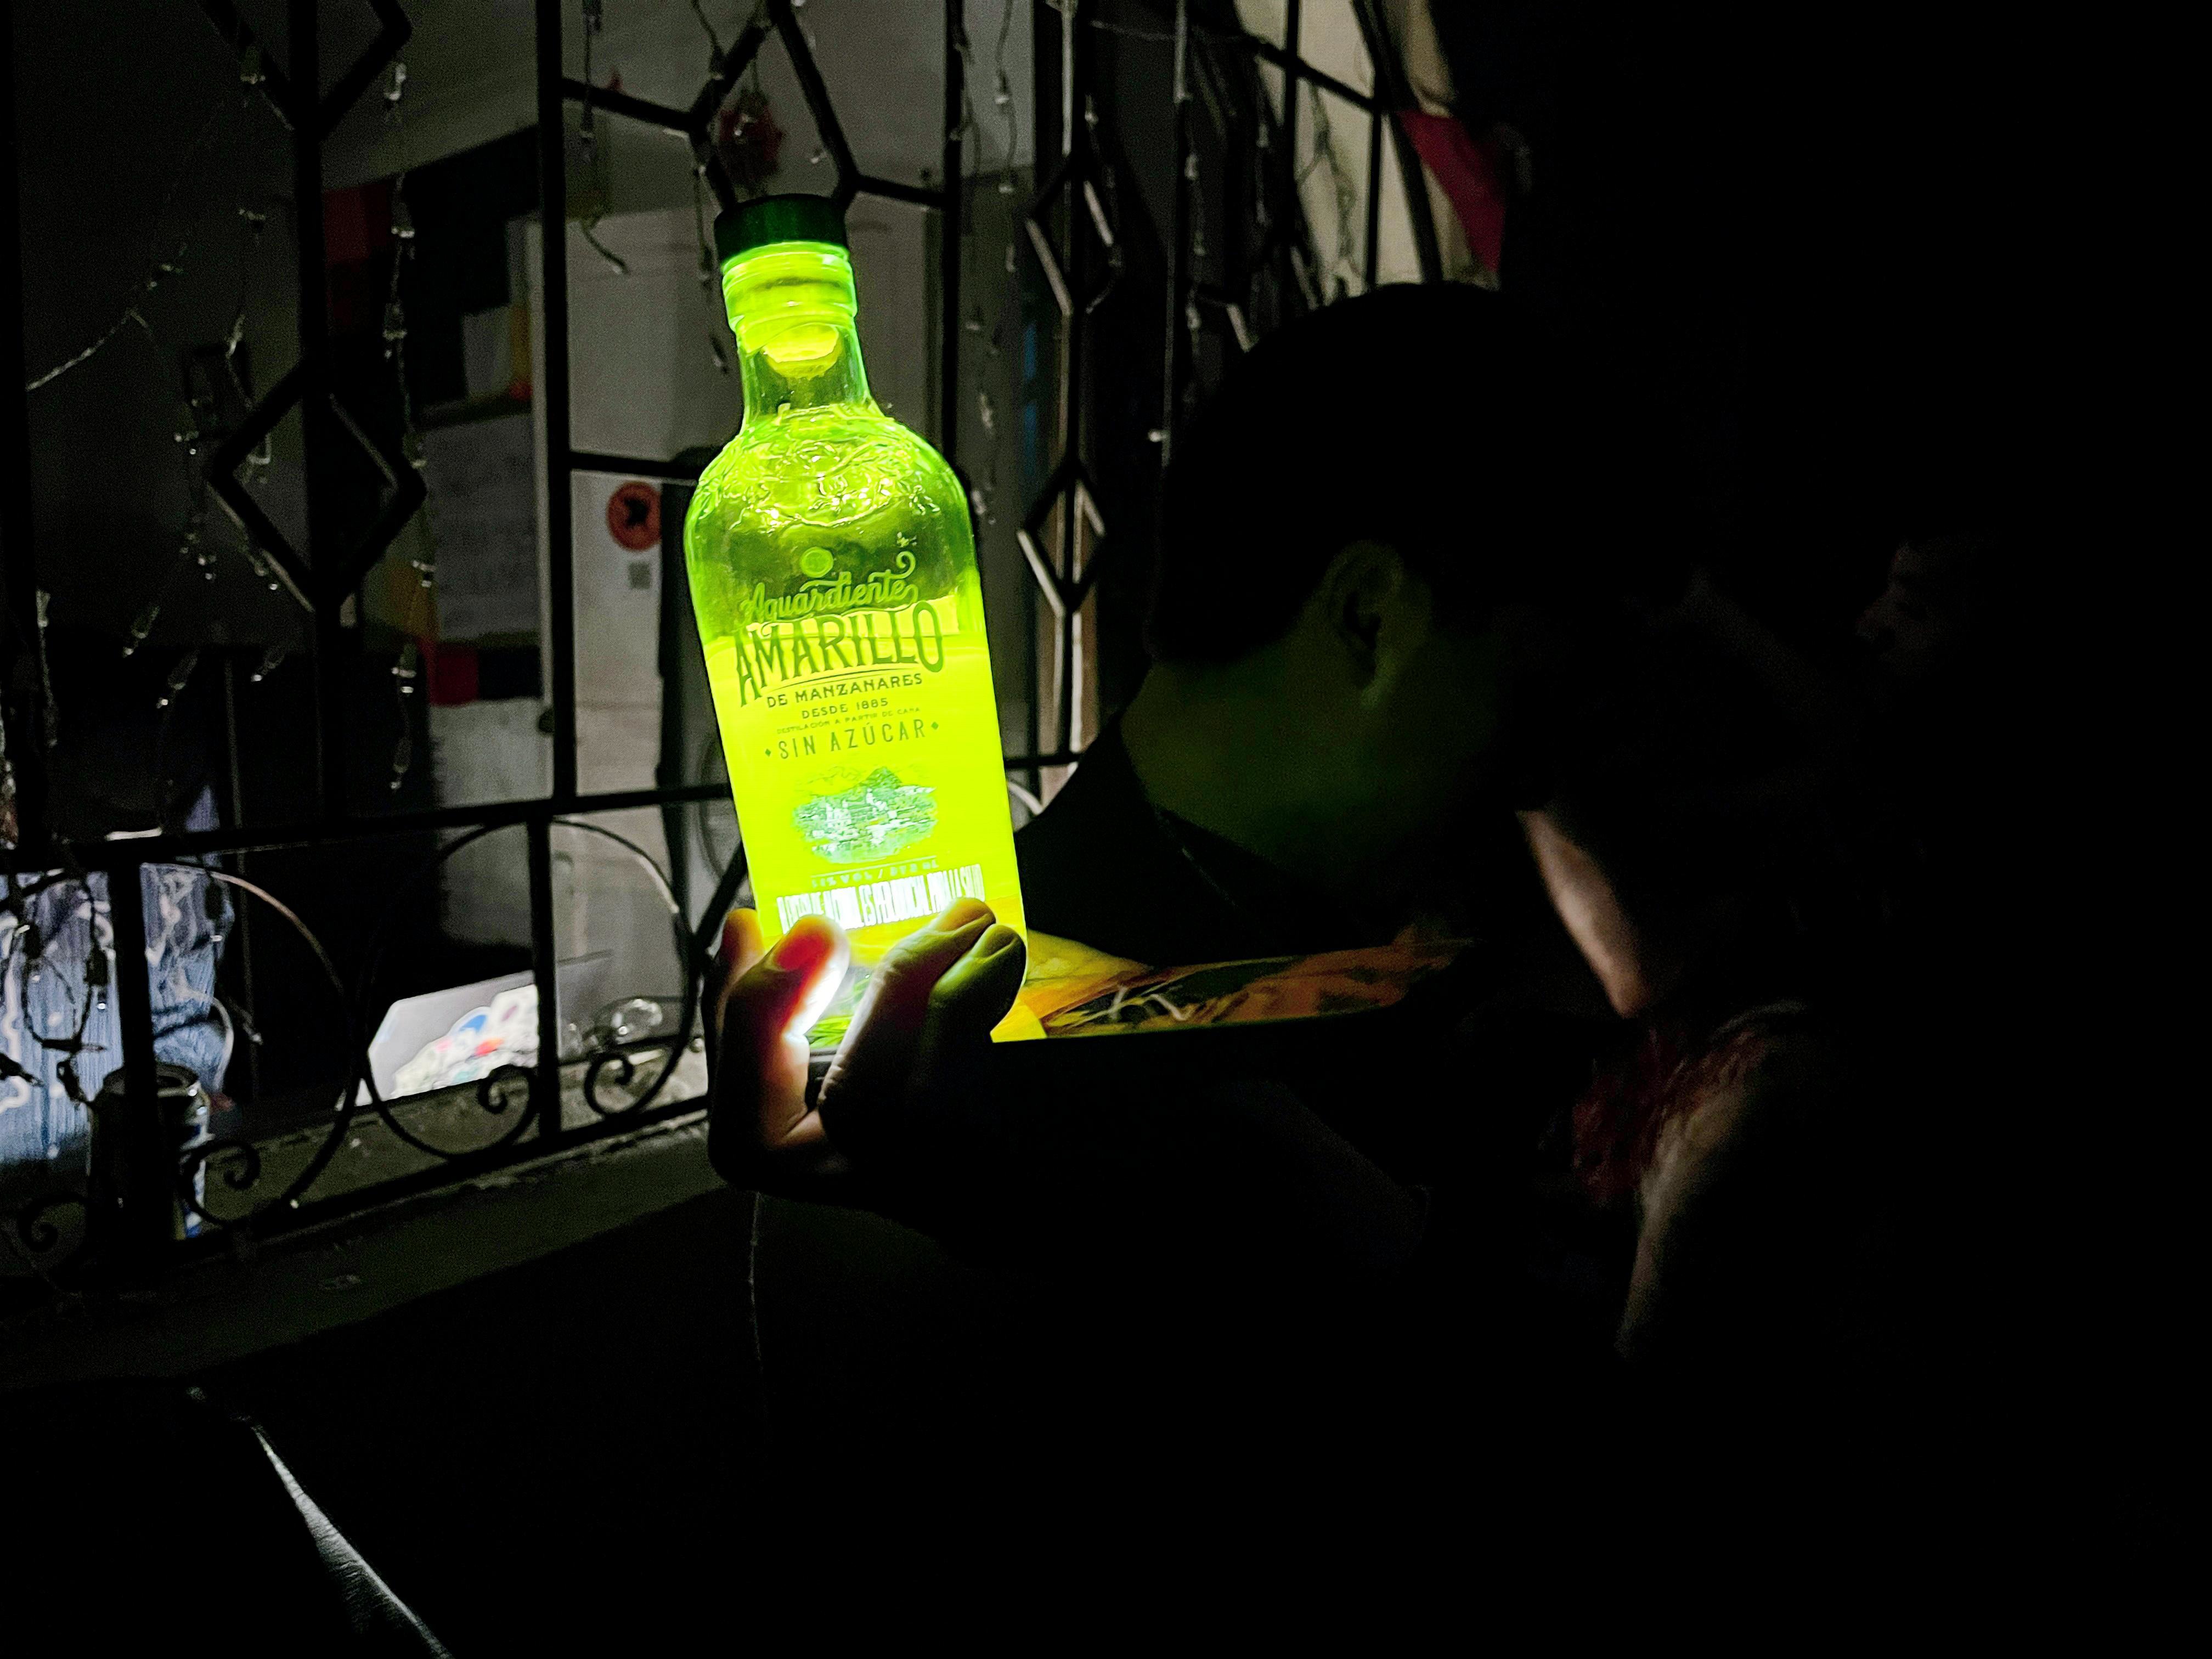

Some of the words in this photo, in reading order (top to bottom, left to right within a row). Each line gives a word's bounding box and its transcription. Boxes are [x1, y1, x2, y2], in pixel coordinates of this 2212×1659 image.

[739, 551, 918, 622] Aguardiente
[735, 600, 943, 707] AMARILLO
[766, 694, 788, 708] DE
[795, 673, 923, 703] MANZANARES
[802, 703, 848, 719] DESDE
[856, 698, 888, 710] 1885
[844, 713, 878, 723] PARTIR
[778, 735, 816, 759] SIN
[830, 719, 926, 752] AZÚCAR
